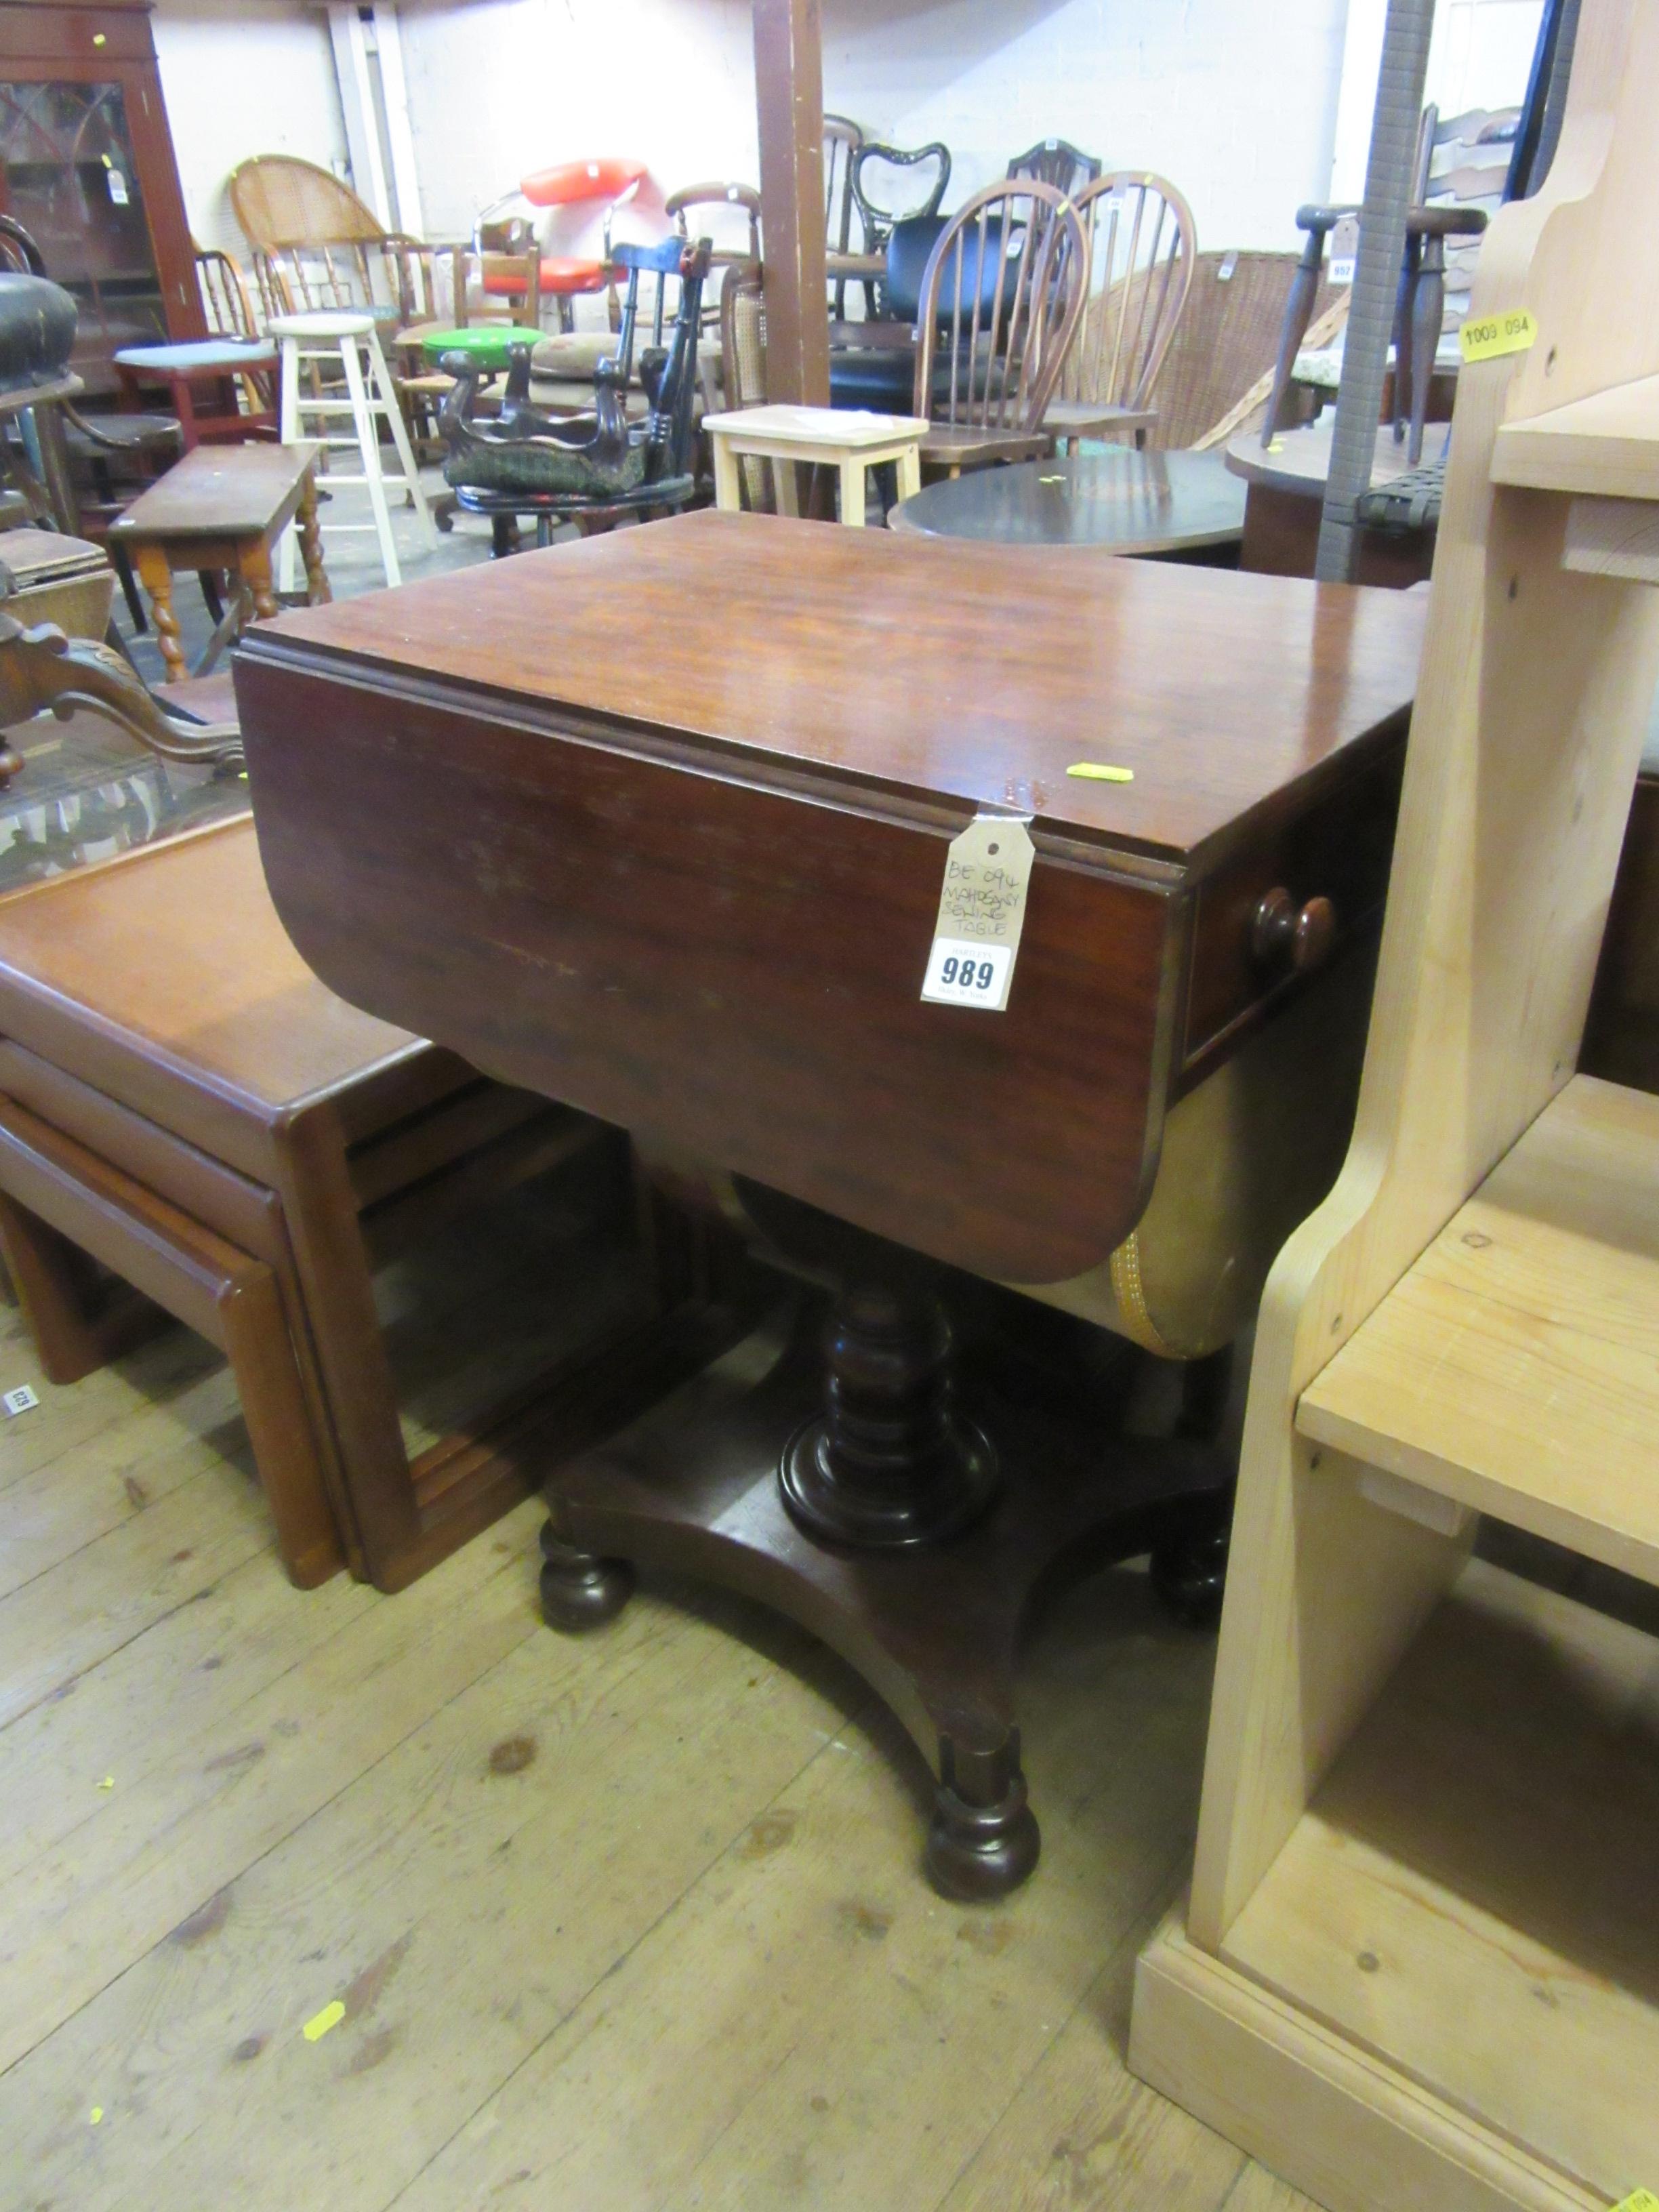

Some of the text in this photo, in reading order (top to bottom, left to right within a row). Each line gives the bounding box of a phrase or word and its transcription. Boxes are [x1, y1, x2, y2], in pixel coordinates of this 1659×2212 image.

[1506, 316, 1529, 336] 094
[954, 918, 1008, 936] TABLE
[941, 957, 994, 990] 989
